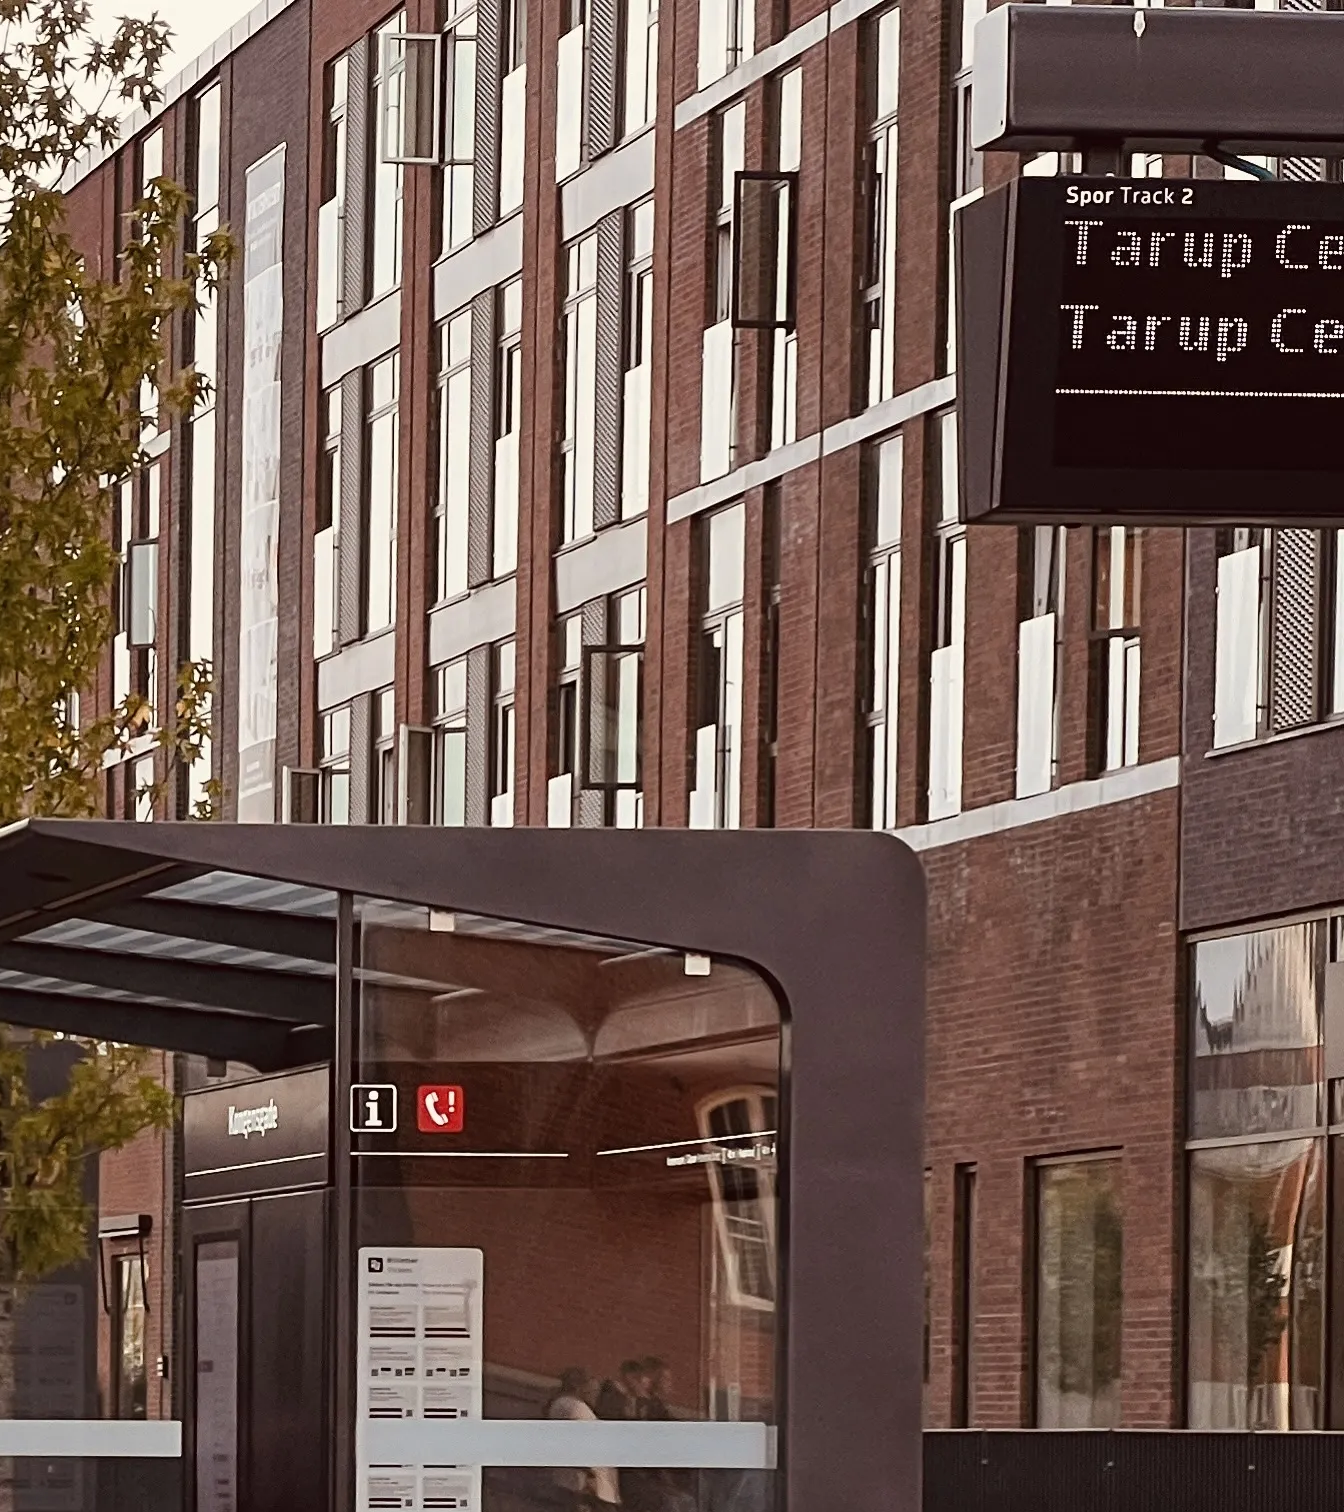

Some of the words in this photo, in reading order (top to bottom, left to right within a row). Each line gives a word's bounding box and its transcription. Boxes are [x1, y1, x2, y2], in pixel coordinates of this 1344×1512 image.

[1066, 185, 1114, 207] Spor
[1120, 186, 1175, 205] Track
[1181, 187, 1194, 205] 2
[1064, 220, 1252, 278] Tarup
[1060, 304, 1248, 362] Tarup
